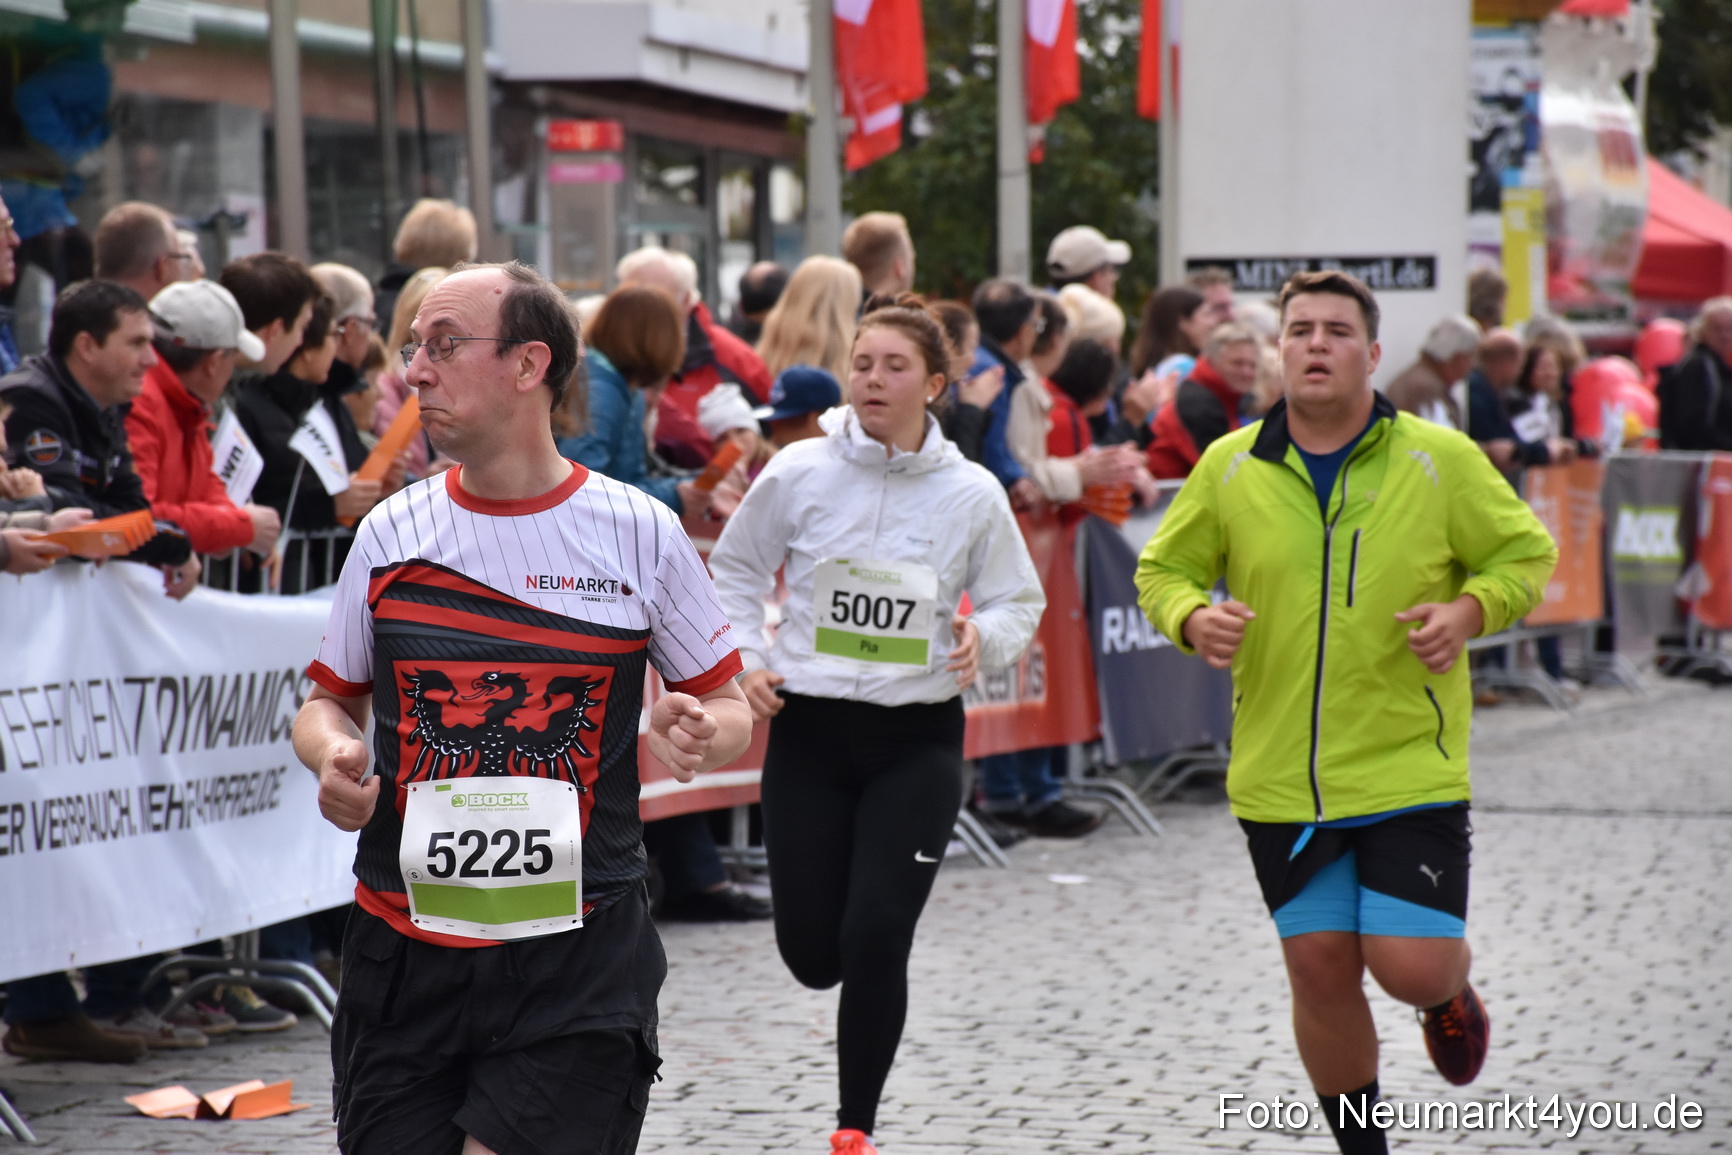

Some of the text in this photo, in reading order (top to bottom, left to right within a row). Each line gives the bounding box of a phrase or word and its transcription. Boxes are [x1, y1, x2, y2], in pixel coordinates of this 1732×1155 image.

[526, 575, 618, 594] NEUMARKT
[831, 590, 916, 630] 5007
[860, 640, 879, 653] Pia
[467, 792, 528, 807] BOCK
[31, 787, 138, 851] VERBRAUCH.
[426, 829, 553, 878] 5225
[411, 871, 418, 879] S
